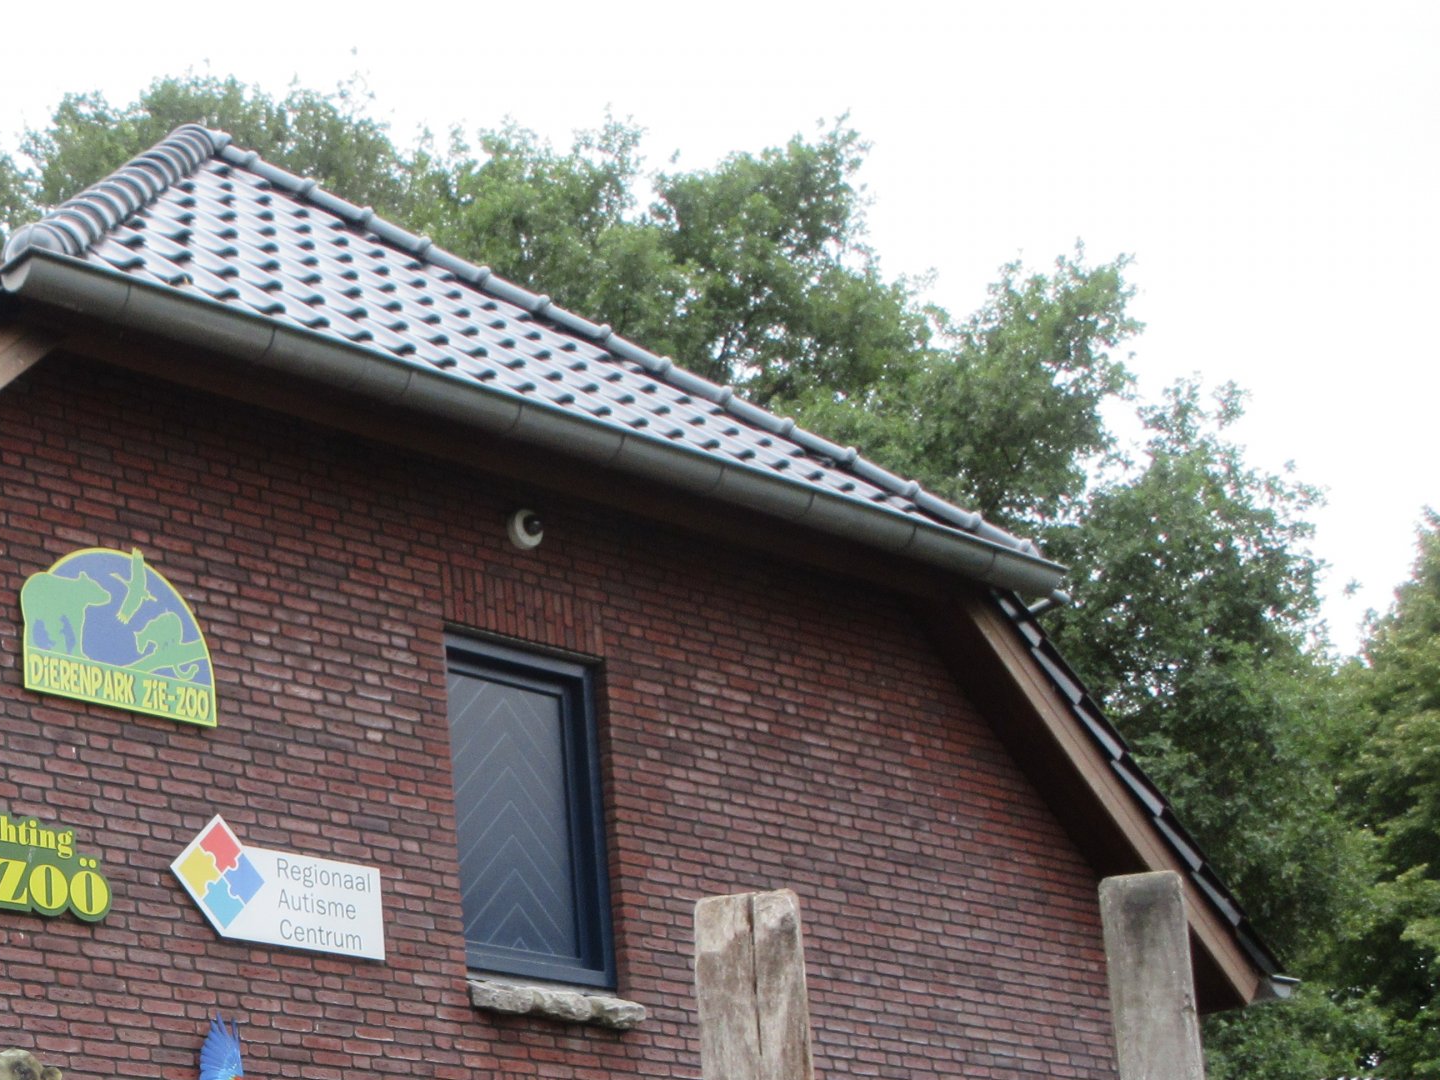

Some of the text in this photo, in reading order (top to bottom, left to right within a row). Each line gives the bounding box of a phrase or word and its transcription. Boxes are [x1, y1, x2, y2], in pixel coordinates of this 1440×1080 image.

[276, 857, 371, 893] Regionaal
[278, 889, 357, 920] Autisme
[279, 919, 362, 951] Centrum
